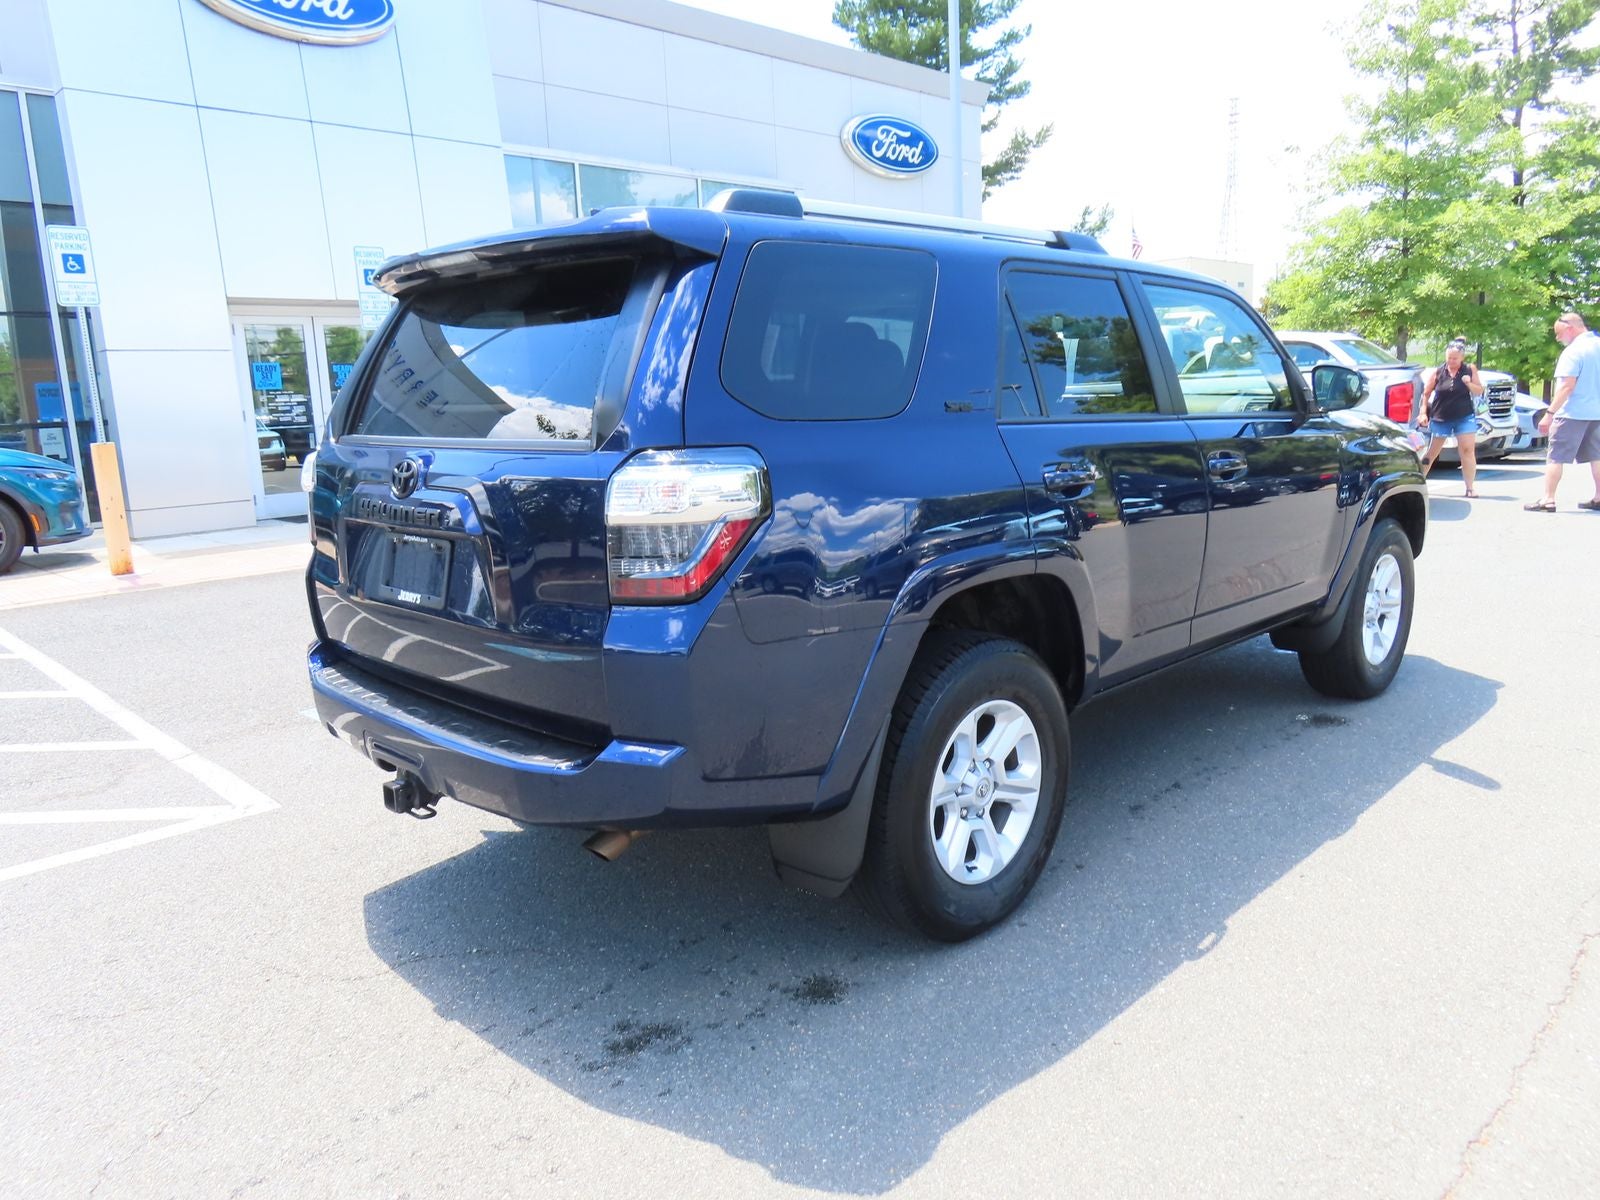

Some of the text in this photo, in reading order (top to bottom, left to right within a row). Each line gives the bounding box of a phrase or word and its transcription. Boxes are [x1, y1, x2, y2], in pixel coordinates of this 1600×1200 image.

[871, 124, 924, 165] Ford
[49, 231, 88, 241] RESERVED
[54, 242, 88, 251] PARKING
[255, 364, 277, 373] READY
[261, 372, 273, 380] SET
